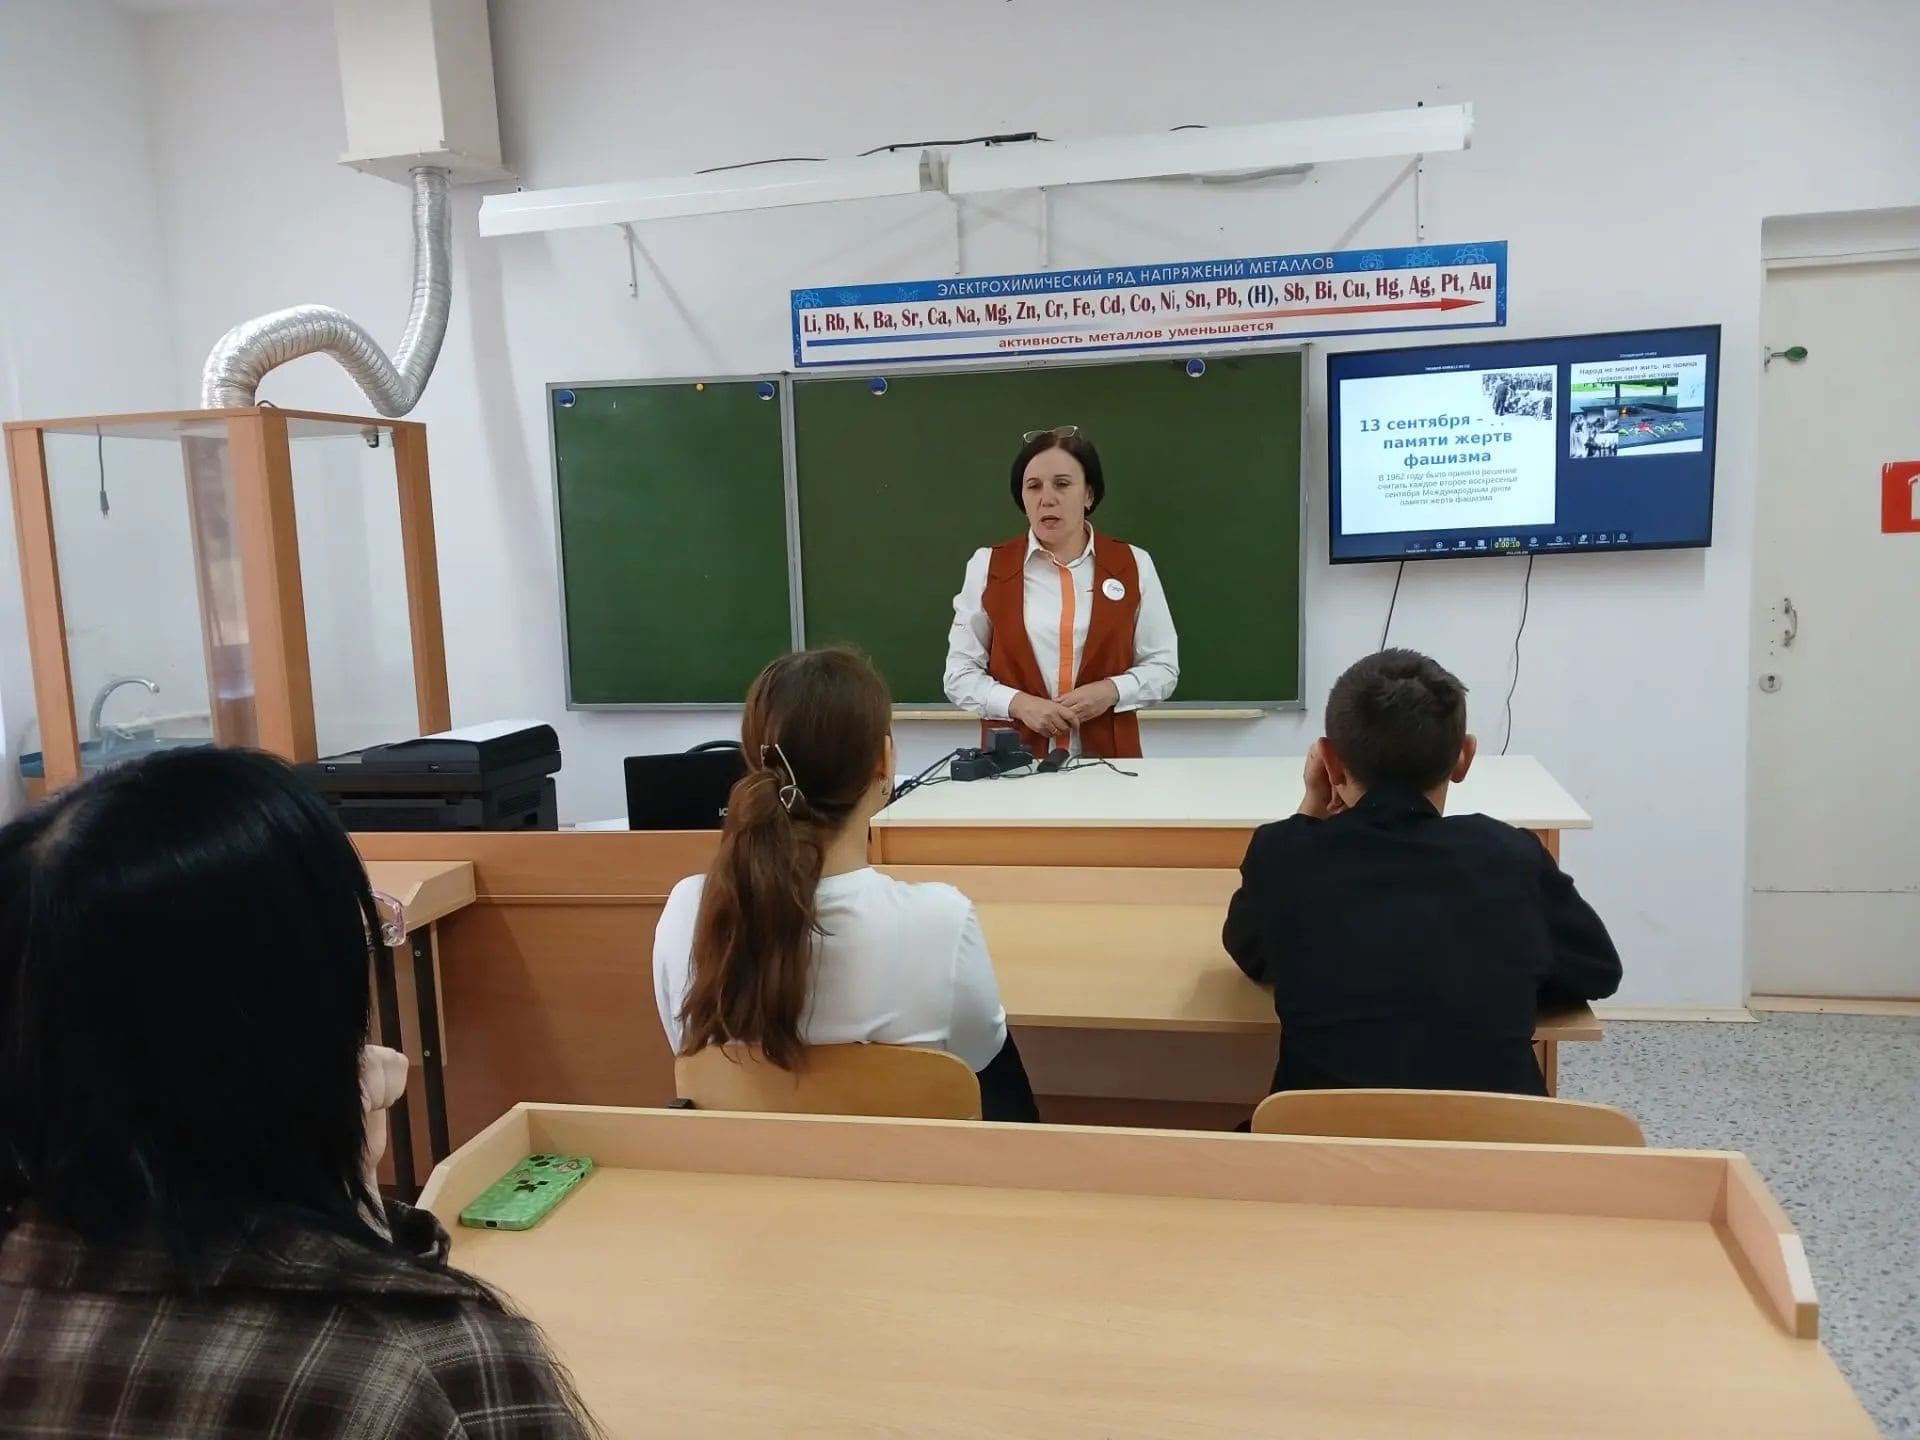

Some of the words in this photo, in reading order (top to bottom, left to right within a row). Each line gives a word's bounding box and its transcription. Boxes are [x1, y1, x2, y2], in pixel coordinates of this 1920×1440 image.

[938, 270, 1101, 296] ЭЛЕКТРОХИМИЧЕСКИЙ
[1107, 271, 1136, 285] РЯД
[1141, 260, 1244, 281] НАПРЯЖЕНИЙ
[1249, 257, 1334, 275] МЕТАЛЛОВ
[804, 314, 821, 334] Li,
[826, 313, 850, 333] Rb,
[854, 311, 869, 331] K,
[873, 310, 897, 330] Ba,
[901, 308, 923, 328] Sr,
[927, 307, 952, 327] Ca,
[956, 305, 981, 327] Na,
[985, 303, 1012, 325] Mg,
[1016, 301, 1041, 321] Zn,
[1045, 299, 1068, 319] Cr,
[1073, 298, 1096, 318] Fe,
[1100, 295, 1125, 315] Cd,
[1130, 293, 1156, 314] Co,
[1160, 290, 1180, 311] Ni,
[1185, 289, 1211, 310] Sn,
[1216, 287, 1242, 308] Pb,
[1247, 284, 1279, 308] (H),
[1284, 282, 1310, 303] Sb,
[1315, 280, 1337, 301] Bi,
[1342, 279, 1370, 299] Cu,
[1376, 277, 1404, 299] Hg,
[1409, 275, 1435, 297] Ag,
[1441, 273, 1464, 294] Pt,
[1469, 271, 1492, 291] Au
[999, 335, 1083, 348] активность
[1088, 329, 1162, 343] металлов
[1168, 321, 1274, 340] уменьшается
[1360, 418, 1380, 432] 13
[1387, 413, 1471, 431] сентября
[1383, 434, 1449, 449] памяти
[1455, 430, 1513, 447] жертв
[1403, 450, 1492, 469] фашизма
